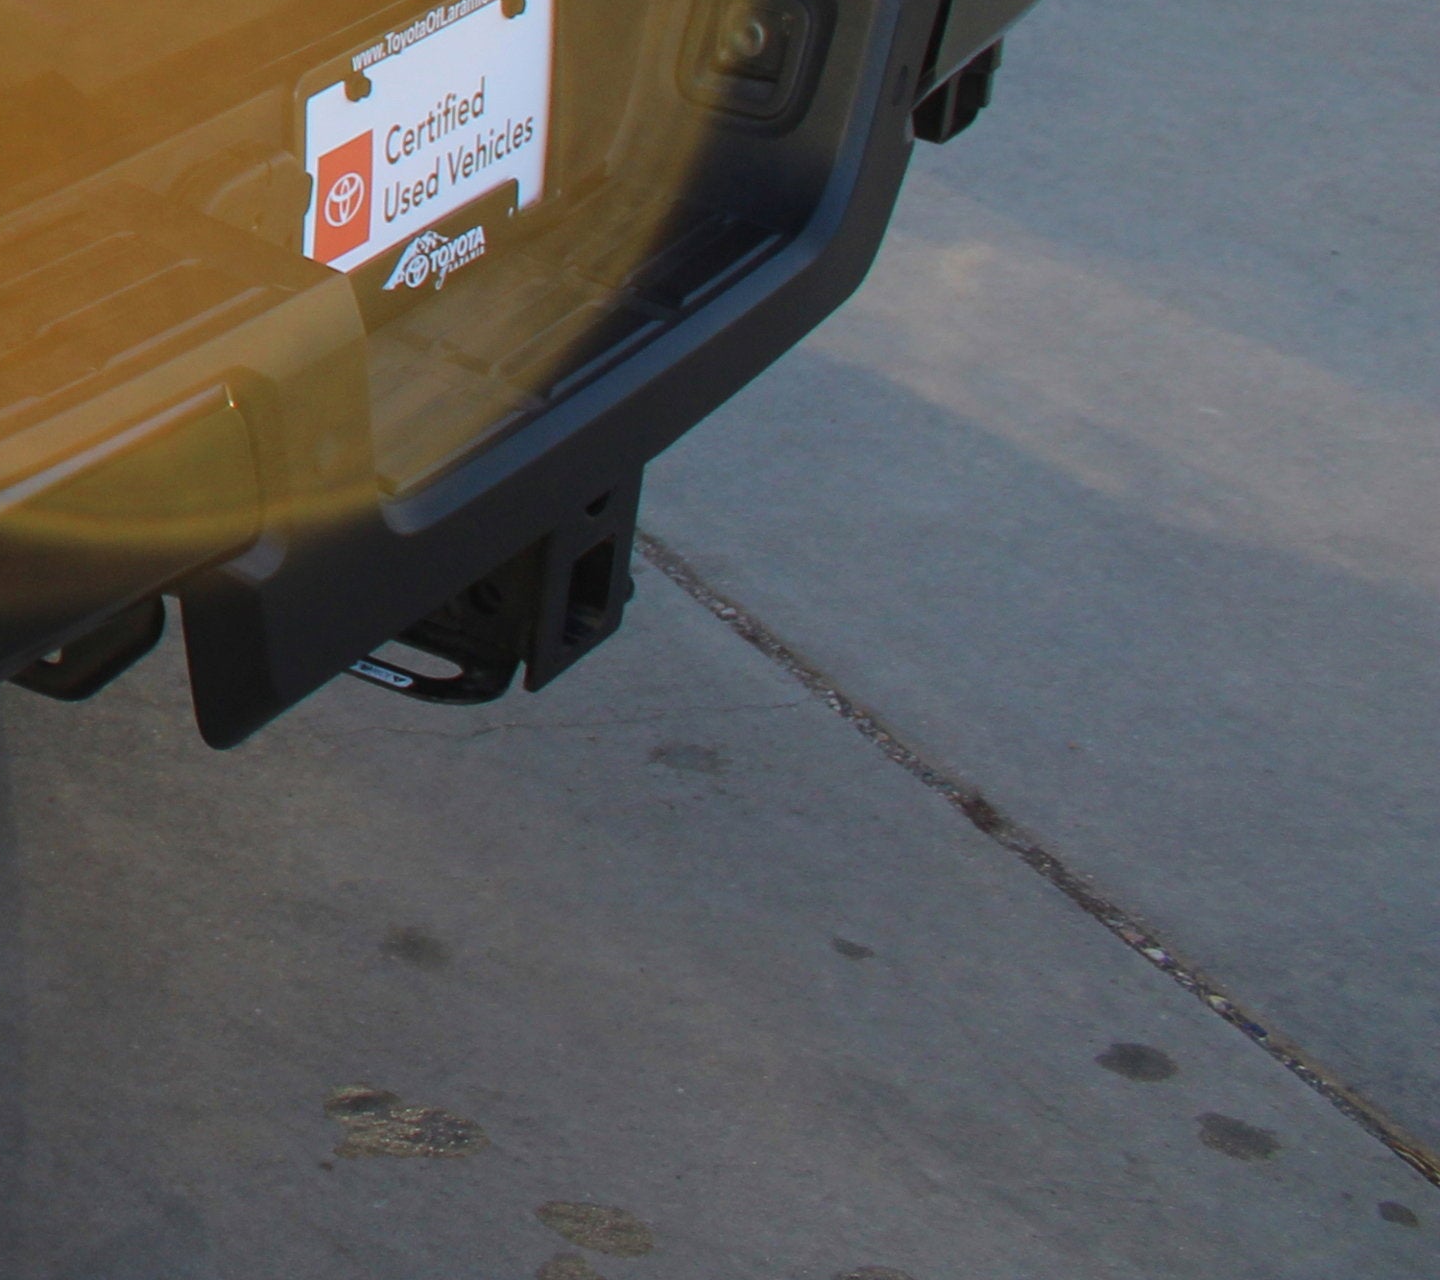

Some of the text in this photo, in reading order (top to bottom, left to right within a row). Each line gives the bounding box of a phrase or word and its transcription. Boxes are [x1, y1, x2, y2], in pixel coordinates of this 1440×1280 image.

[385, 75, 486, 165] Certified
[384, 116, 534, 223] Used Vehicles
[429, 225, 485, 273] TOYOTA
